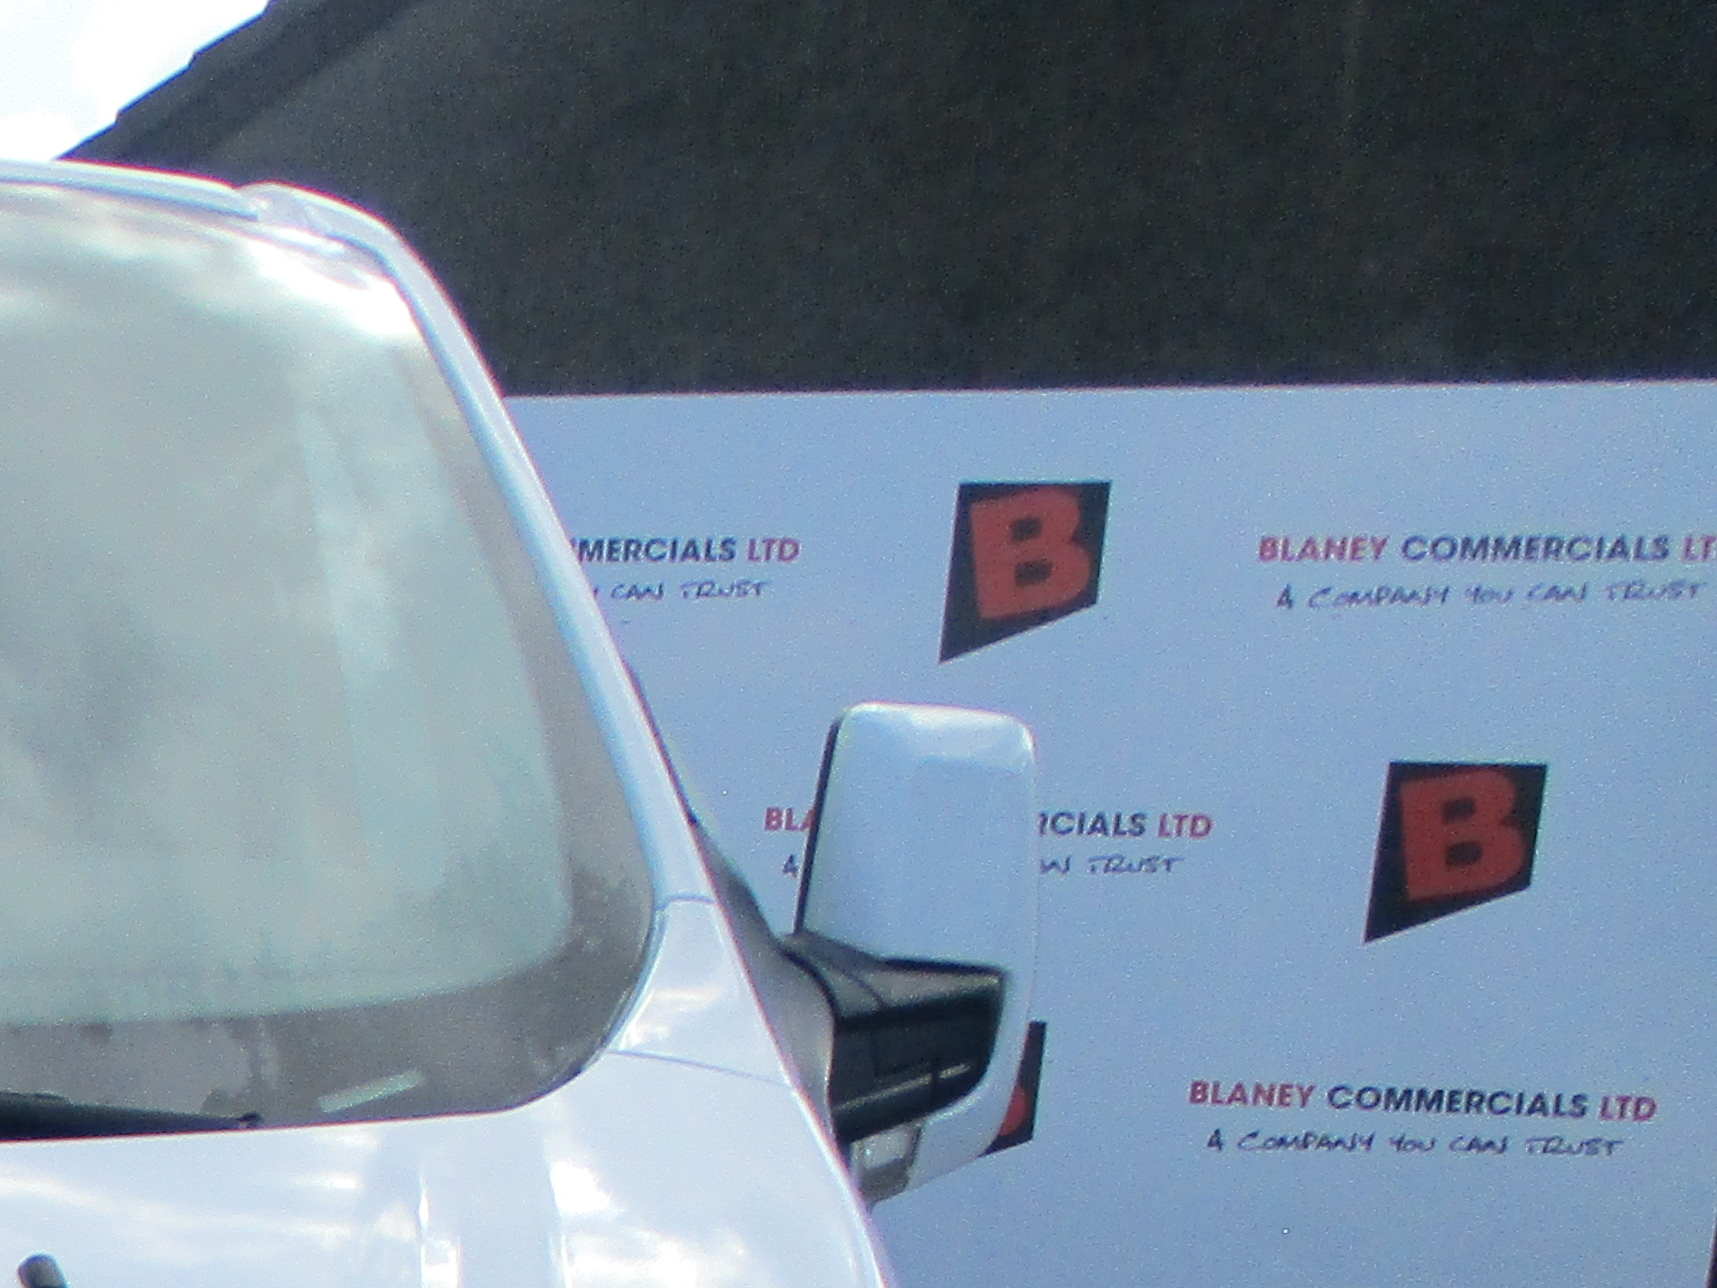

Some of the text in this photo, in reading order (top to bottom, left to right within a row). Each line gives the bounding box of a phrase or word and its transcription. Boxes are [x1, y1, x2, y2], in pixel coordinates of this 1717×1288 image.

[571, 537, 801, 563] MERCIALS LTD
[970, 490, 1091, 619] B
[1258, 534, 1717, 562] BLANEY COMMERCIALS LT
[611, 582, 664, 600] CAN
[680, 578, 773, 600] TRUST
[1276, 577, 1708, 609] A COMPANY YOU CAN TRUST
[1158, 813, 1214, 839] LTD
[1401, 767, 1527, 900] B
[1087, 853, 1186, 874] TRUST
[1189, 1080, 1657, 1122] BLANEY COMMERCIALS LTD
[1207, 1129, 1624, 1158] A COMPANY YOU CAN TRUST
